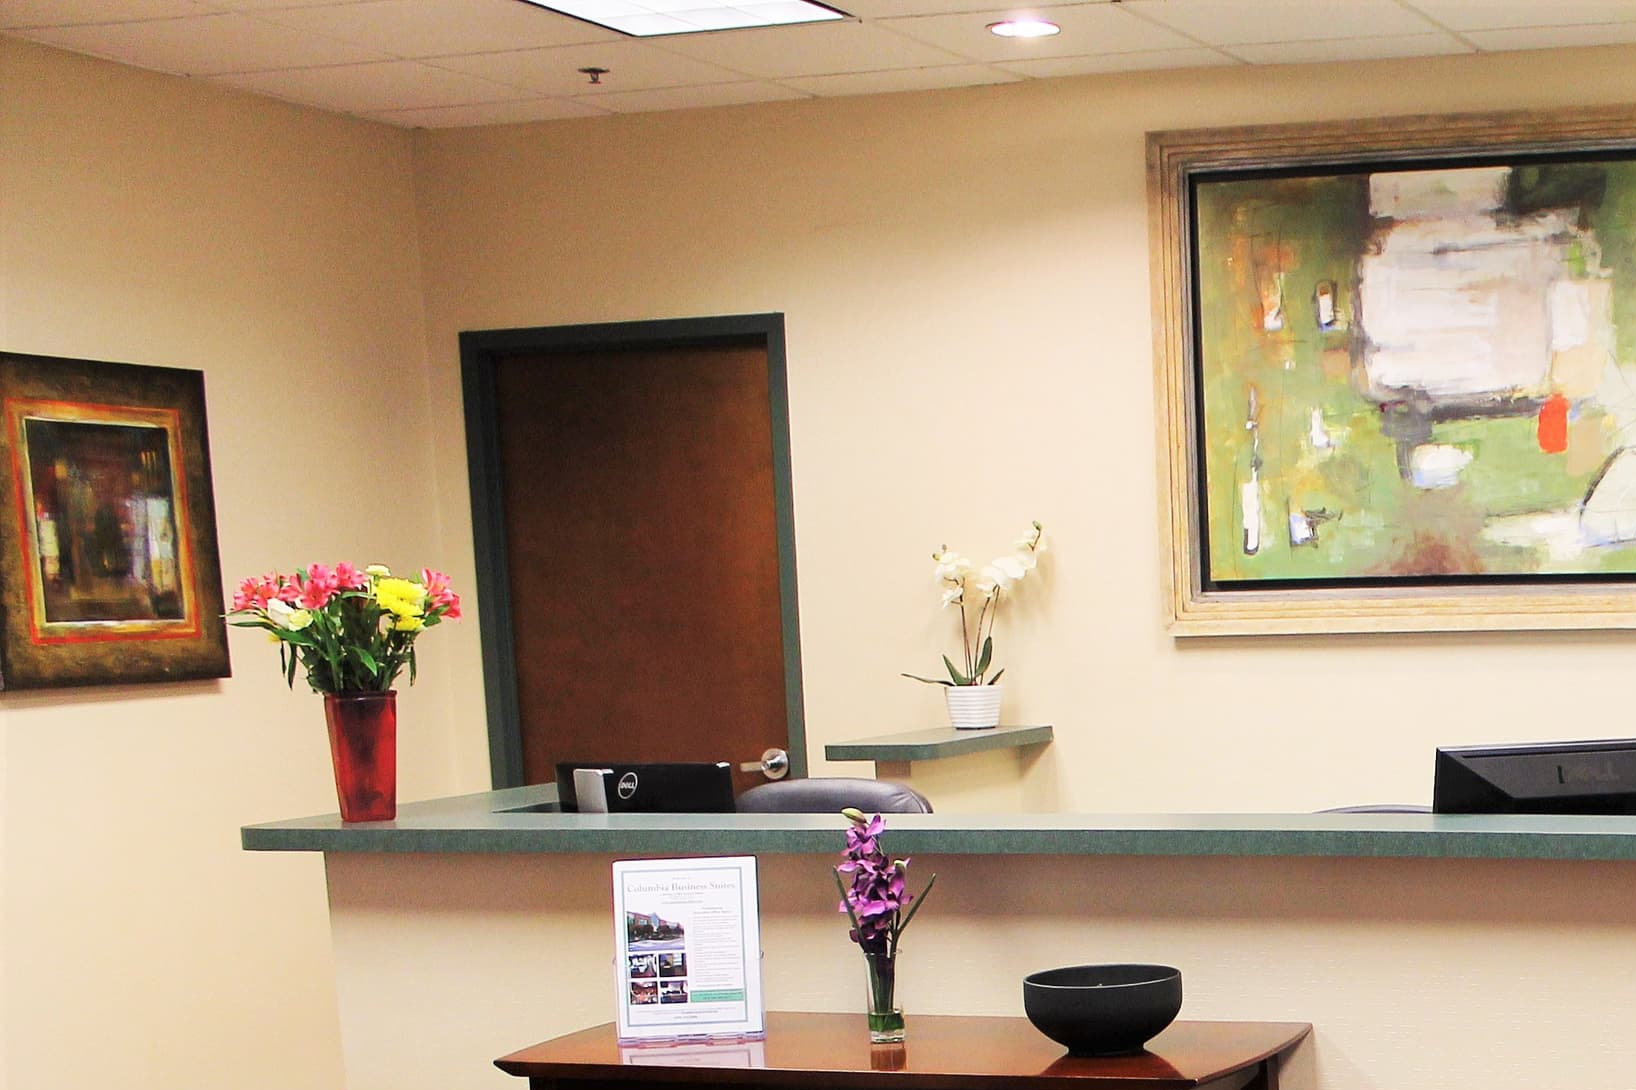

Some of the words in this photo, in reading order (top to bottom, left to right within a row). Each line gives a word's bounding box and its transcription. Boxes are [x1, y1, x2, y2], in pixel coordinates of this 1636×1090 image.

[627, 884, 669, 893] Columbia
[671, 882, 708, 891] Business
[709, 881, 736, 889] Suites
